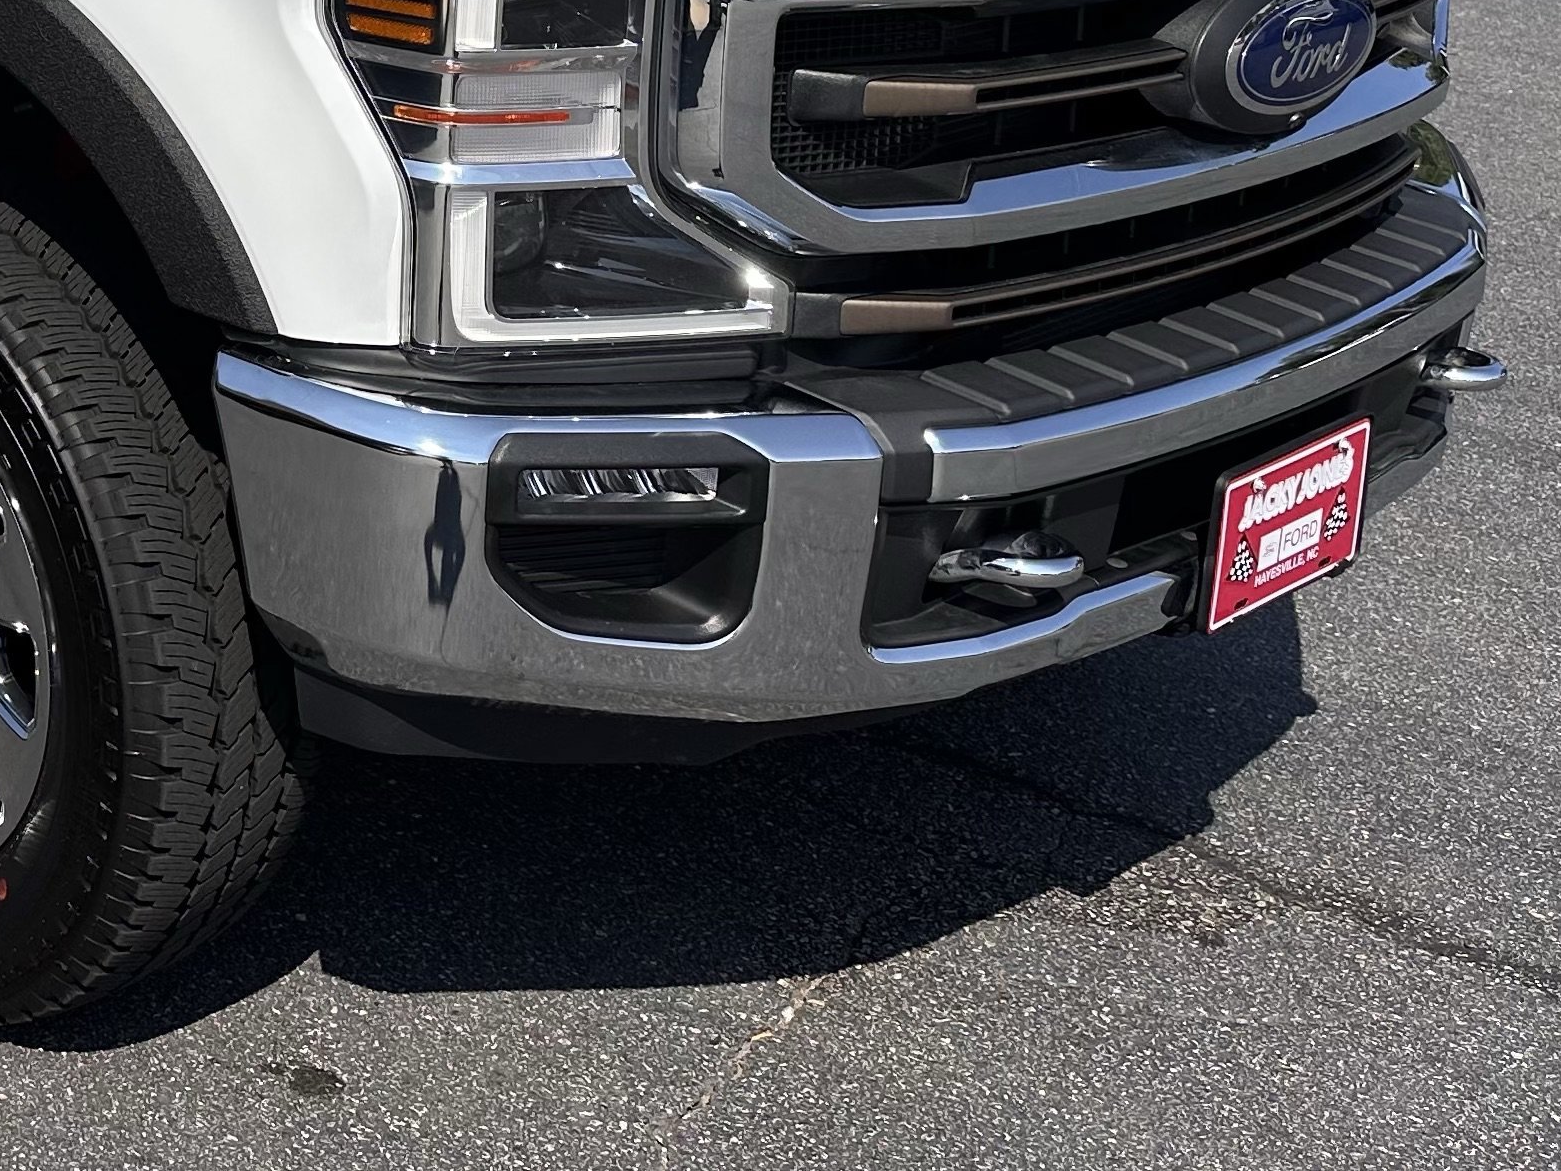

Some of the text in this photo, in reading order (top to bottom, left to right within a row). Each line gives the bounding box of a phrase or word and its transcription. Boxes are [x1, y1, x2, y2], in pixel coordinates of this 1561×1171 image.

[1270, 10, 1353, 89] Ford
[1238, 447, 1355, 533] JACKY JONES
[1283, 519, 1318, 551] FORD
[1253, 552, 1306, 588] HAYESVILLE,
[1306, 545, 1320, 563] NC
